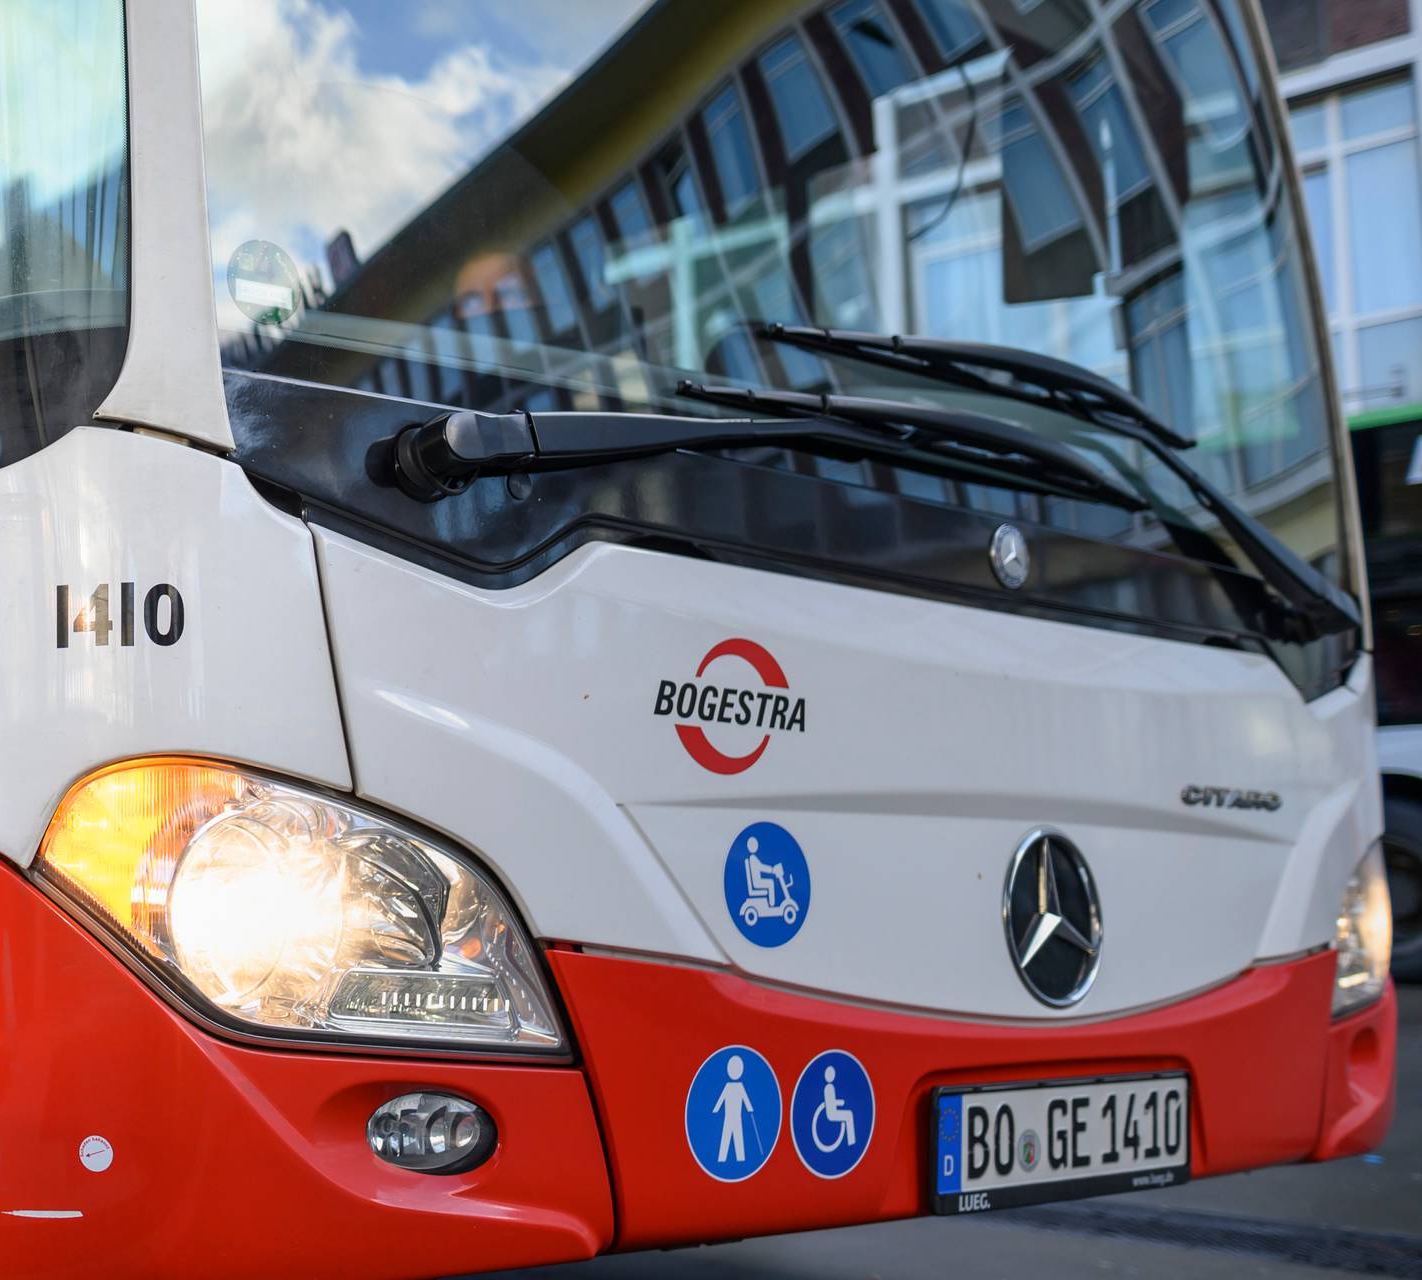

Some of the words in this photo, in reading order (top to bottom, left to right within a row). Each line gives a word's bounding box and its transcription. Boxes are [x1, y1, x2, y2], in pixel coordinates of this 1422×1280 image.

[56, 582, 185, 648] 1410
[653, 679, 806, 732] BOGESTRA
[1180, 785, 1282, 812] CITARO
[967, 1104, 1015, 1180] BO
[1048, 1097, 1091, 1170] GE
[1102, 1089, 1182, 1164] 1410
[943, 1154, 954, 1177] D
[958, 1192, 991, 1212] LUEG.
